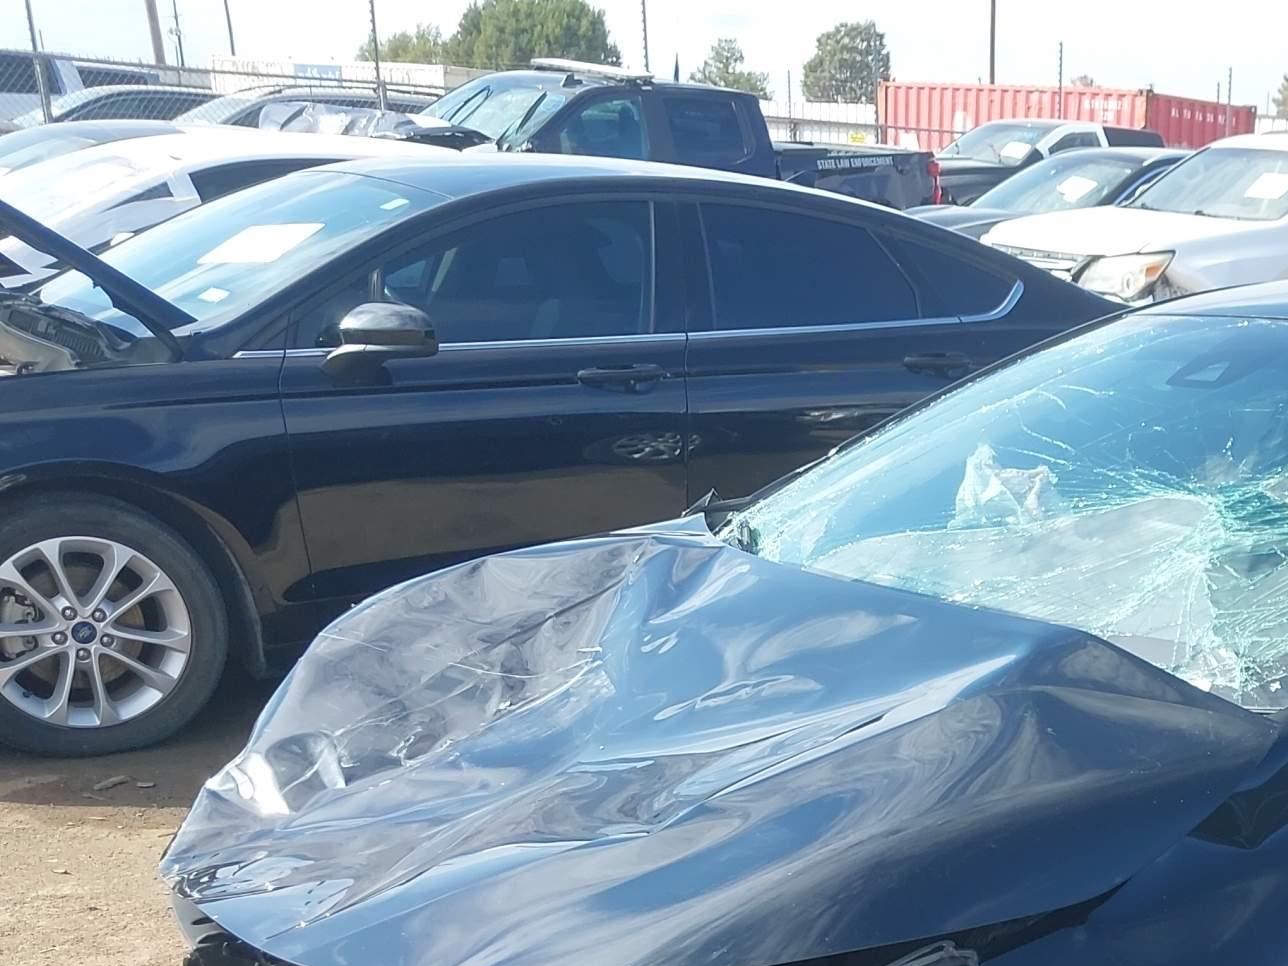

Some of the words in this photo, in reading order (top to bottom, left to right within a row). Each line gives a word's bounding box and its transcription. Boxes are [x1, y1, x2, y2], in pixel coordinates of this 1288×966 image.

[816, 159, 836, 170] STATE
[837, 158, 850, 169] LAW
[850, 156, 893, 168] ENFORCEMENT
